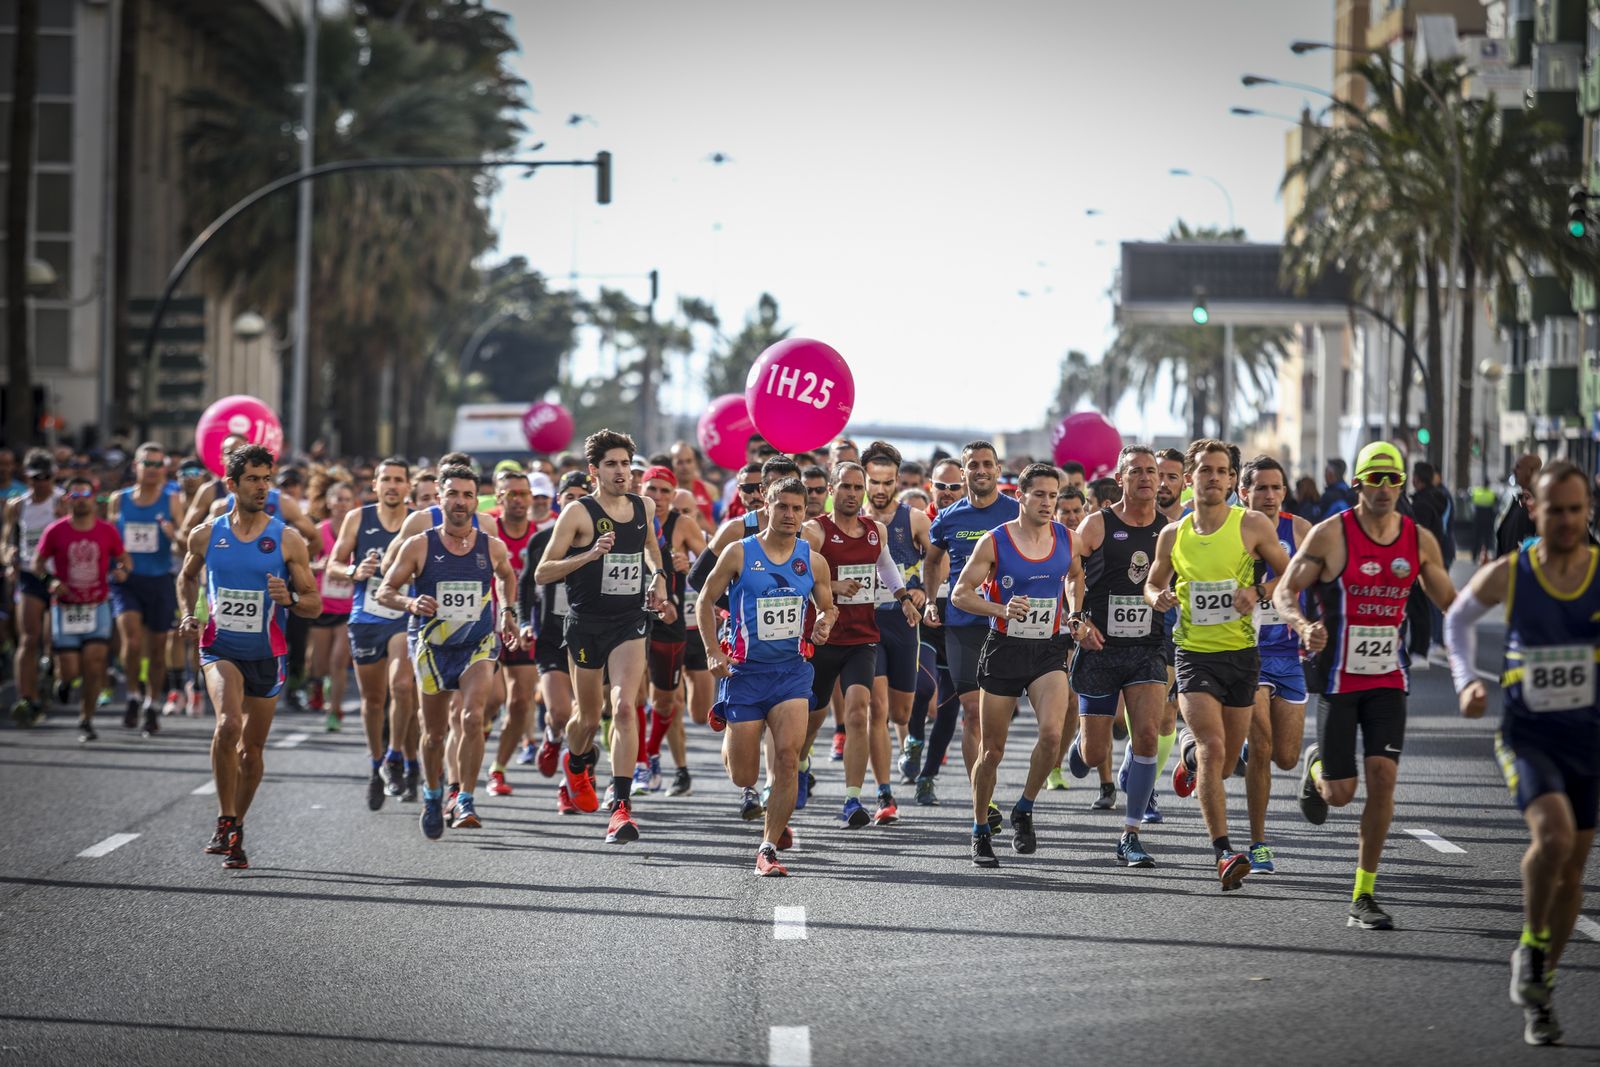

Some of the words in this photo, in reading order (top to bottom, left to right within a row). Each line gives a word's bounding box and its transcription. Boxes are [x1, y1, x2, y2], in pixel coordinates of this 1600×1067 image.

[766, 363, 835, 409] 1H25
[608, 566, 640, 581] 412
[844, 576, 872, 590] 73
[442, 593, 475, 607] 891
[1195, 593, 1233, 610] 920
[221, 601, 257, 617] 229
[763, 608, 797, 625] 615
[1114, 608, 1148, 623] 667
[1357, 603, 1400, 617] SPORT
[1355, 640, 1392, 657] 424
[1532, 665, 1586, 689] 886
